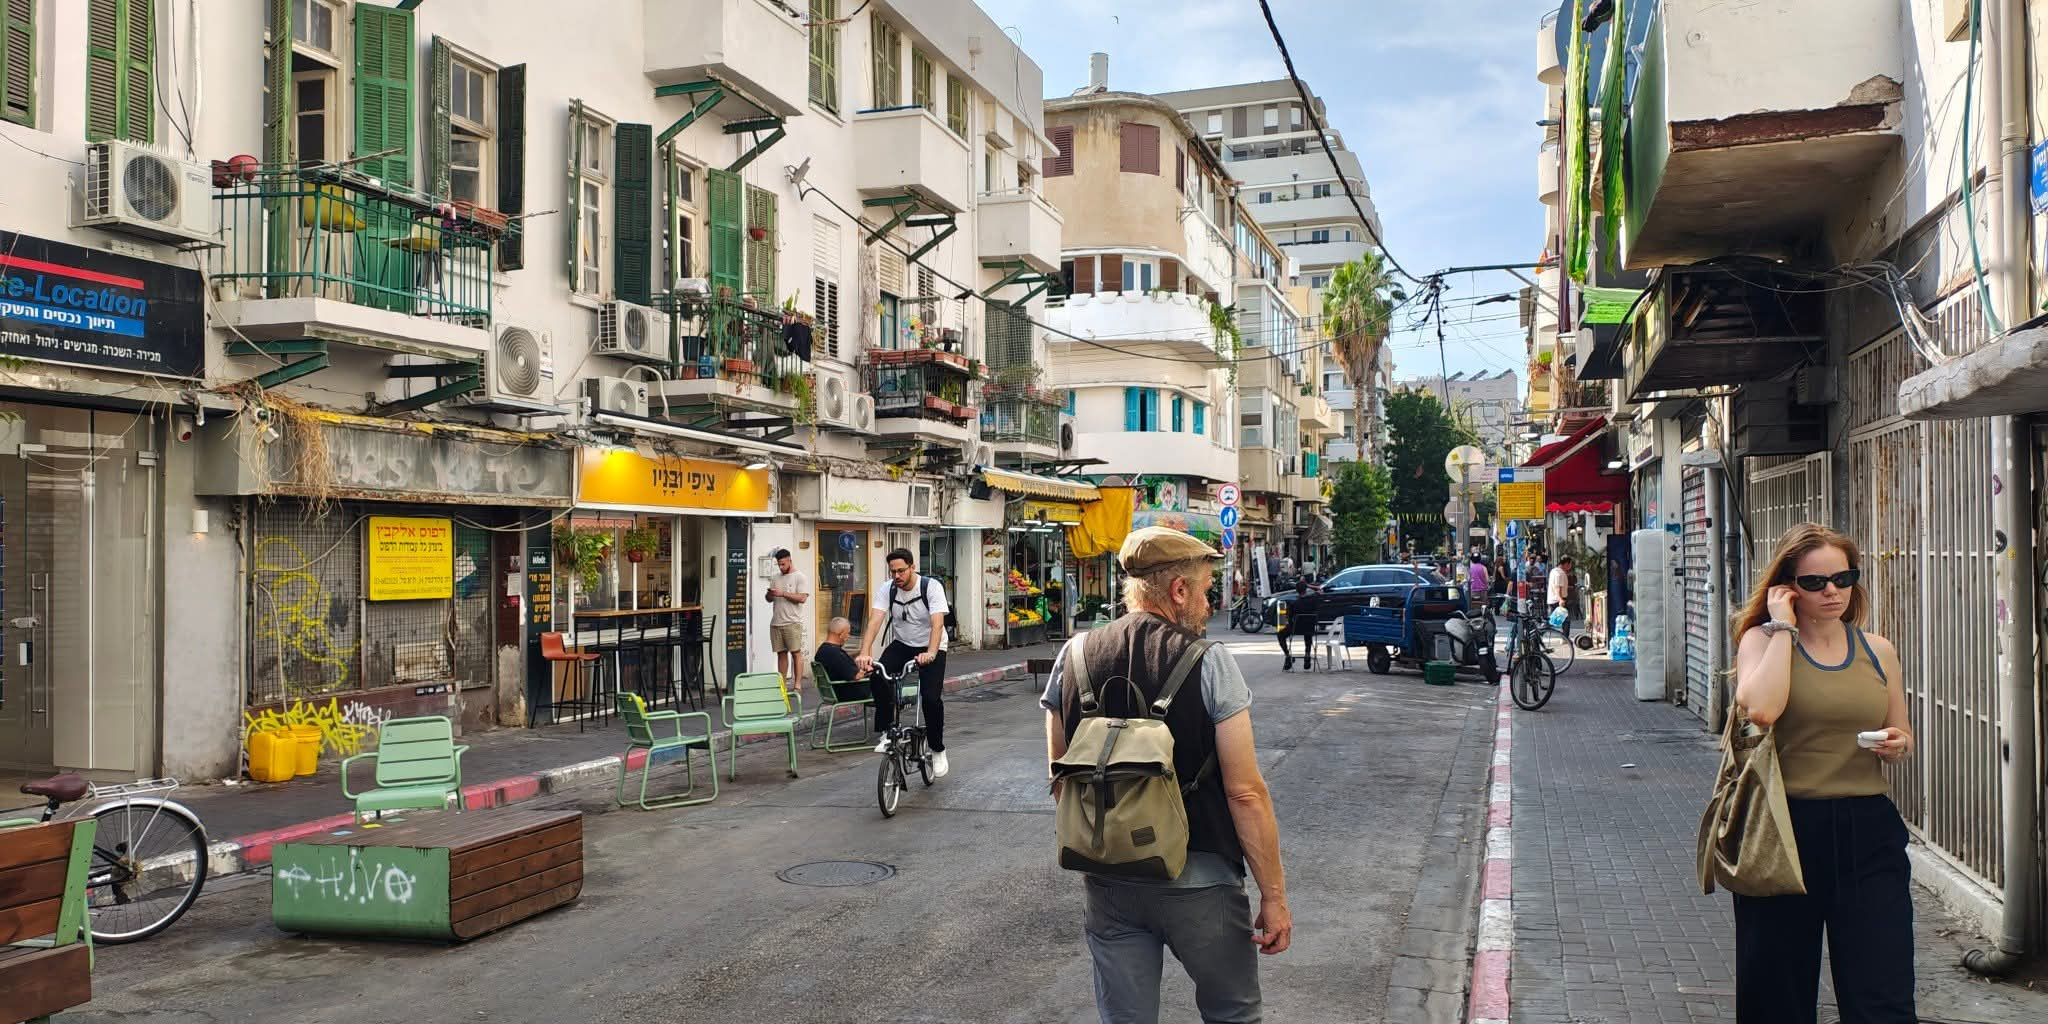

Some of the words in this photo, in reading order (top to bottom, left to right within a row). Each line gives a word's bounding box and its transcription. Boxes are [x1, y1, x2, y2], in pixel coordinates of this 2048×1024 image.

[0, 302, 39, 317] והשק
[43, 308, 82, 324] נכסים
[85, 315, 115, 330] תיווך
[35, 333, 59, 348] ניהול
[63, 339, 98, 354] מגרשים
[102, 345, 132, 359] השכרה
[136, 349, 161, 363] מכירה
[419, 527, 446, 538] דפוס
